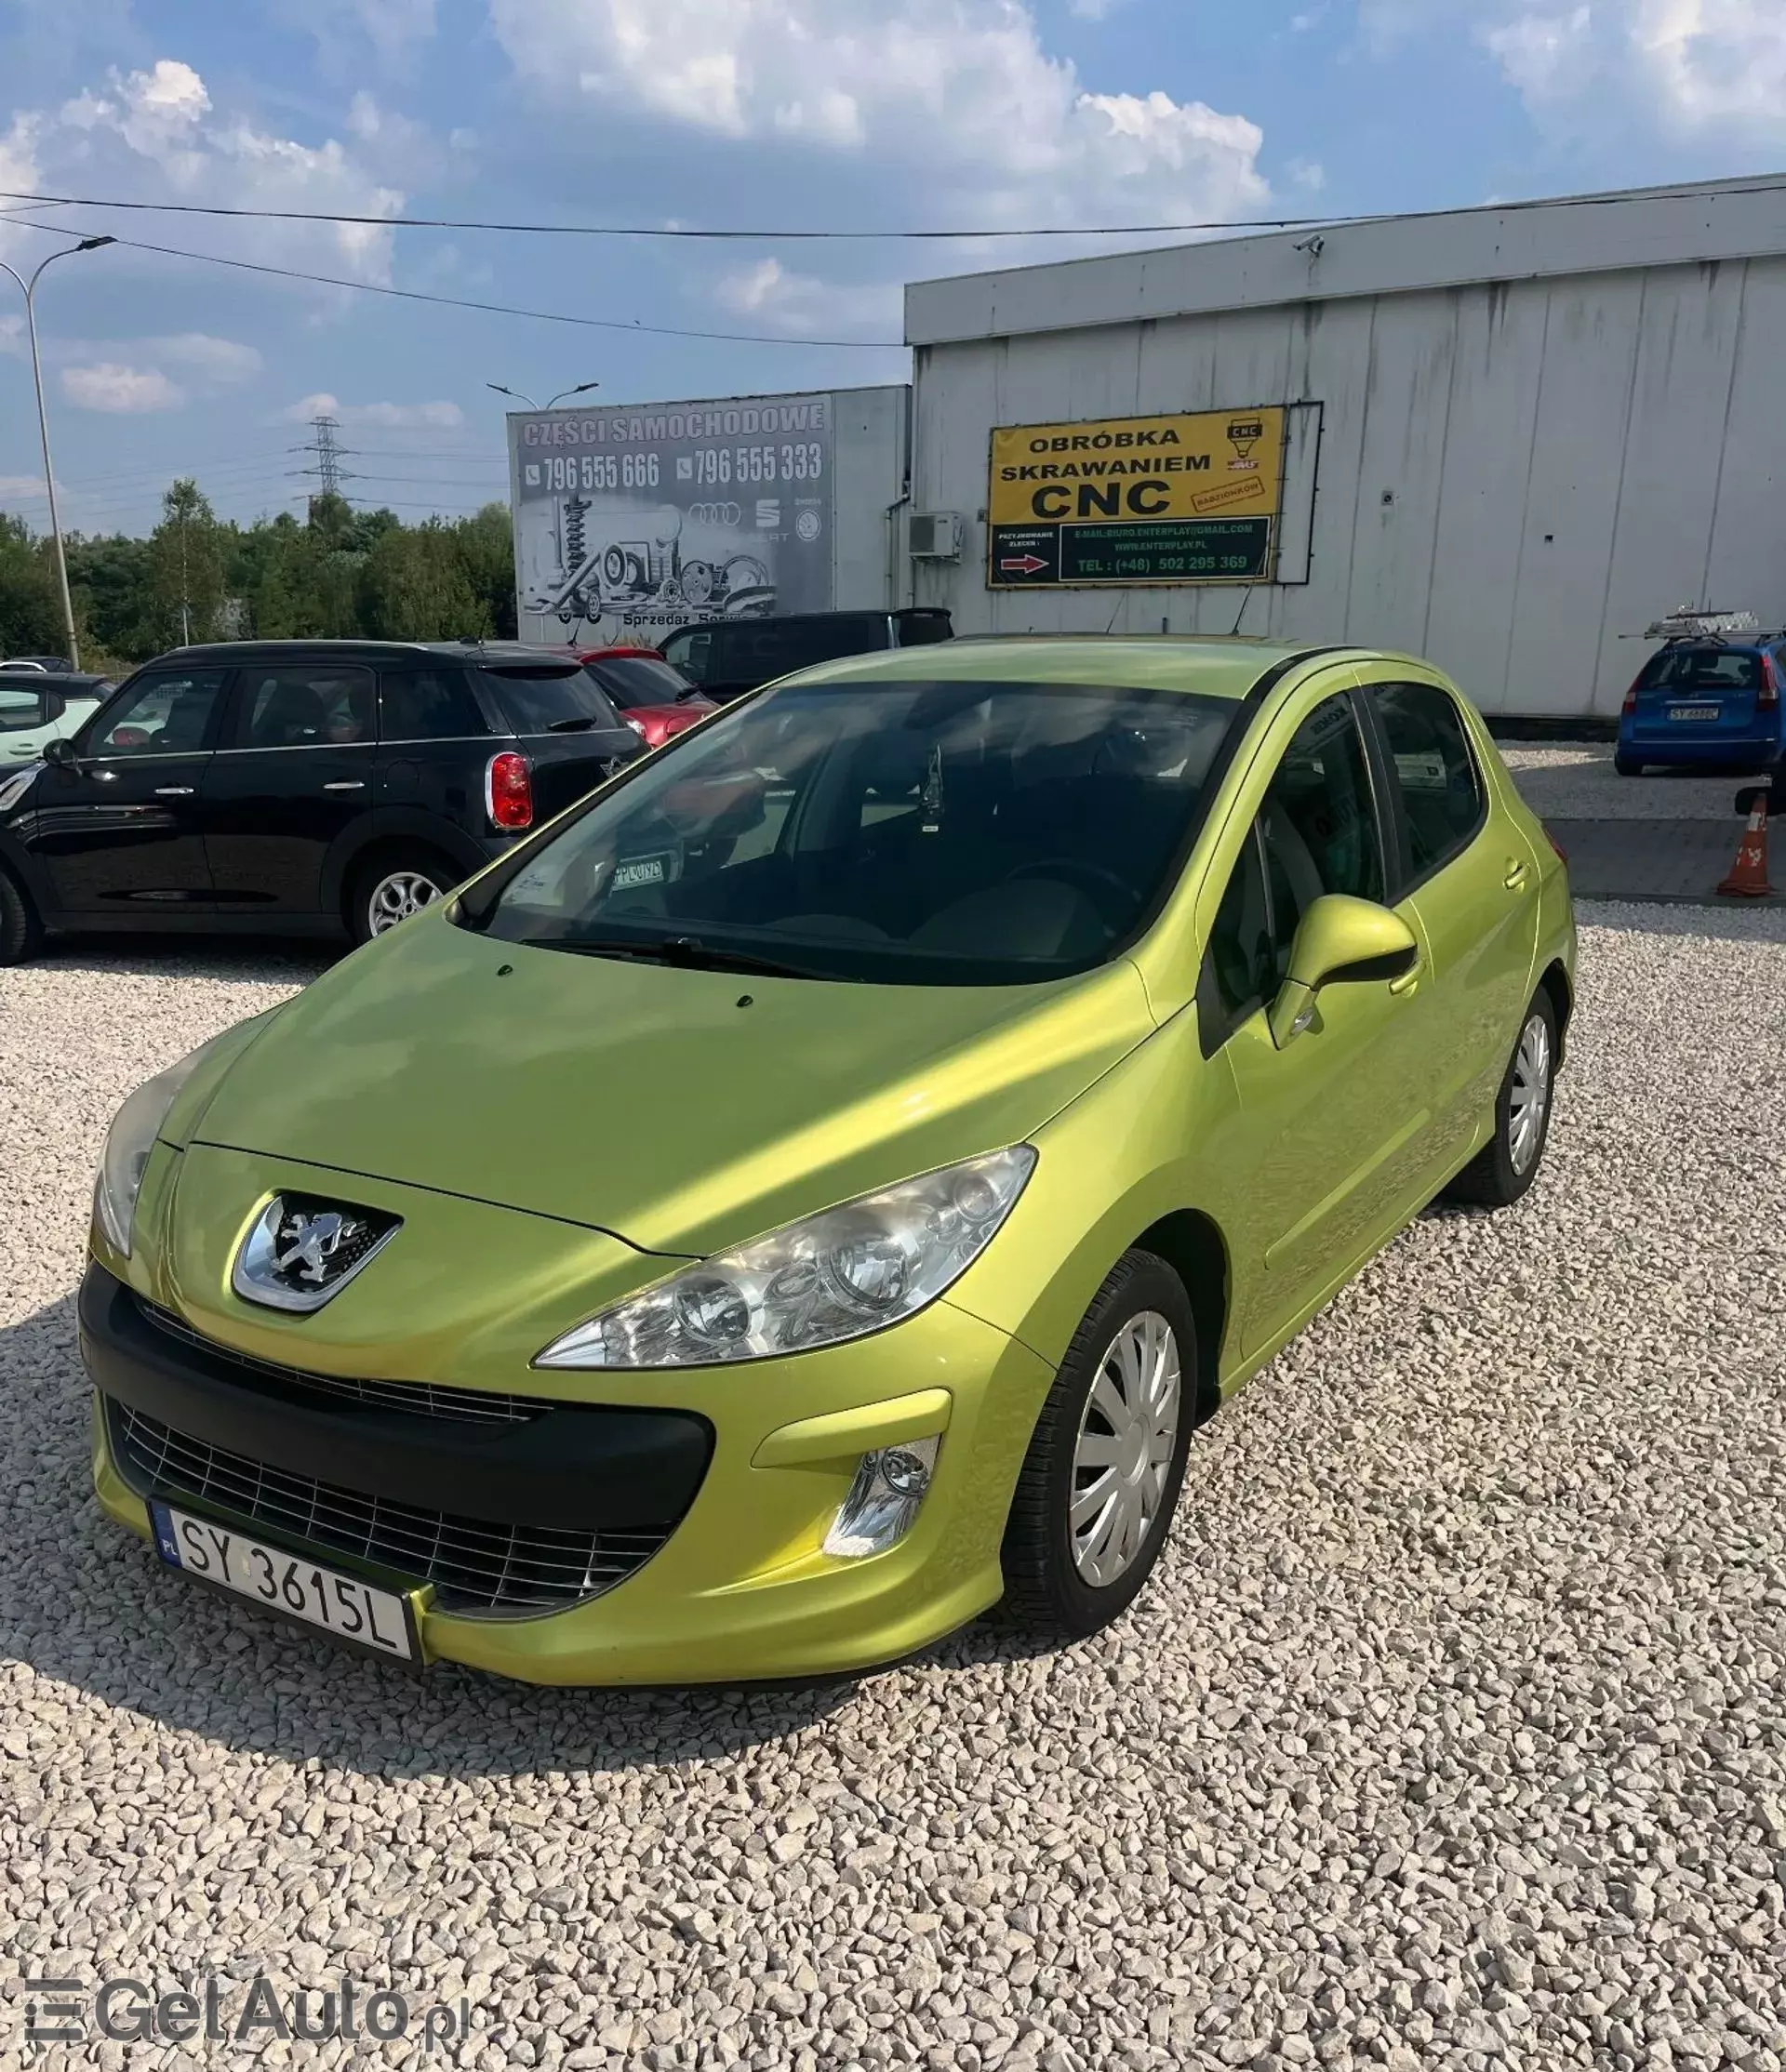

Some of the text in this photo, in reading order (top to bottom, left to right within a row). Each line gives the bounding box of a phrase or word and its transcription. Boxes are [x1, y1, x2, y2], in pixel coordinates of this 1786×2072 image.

[524, 403, 824, 450] CZĘŚCI SAMOCHODOWE
[1029, 429, 1180, 454] OBRÓBKA
[543, 452, 660, 491] 796 555 666
[695, 442, 822, 485] 796 555 333
[1000, 454, 1210, 482] SKRAWANIEM
[1031, 479, 1171, 519] CNC
[1158, 557, 1184, 570] 502
[1189, 556, 1216, 570] 295
[1220, 555, 1247, 569] 369
[162, 1537, 179, 1557] PL
[181, 1520, 397, 1650] SY 3615L
